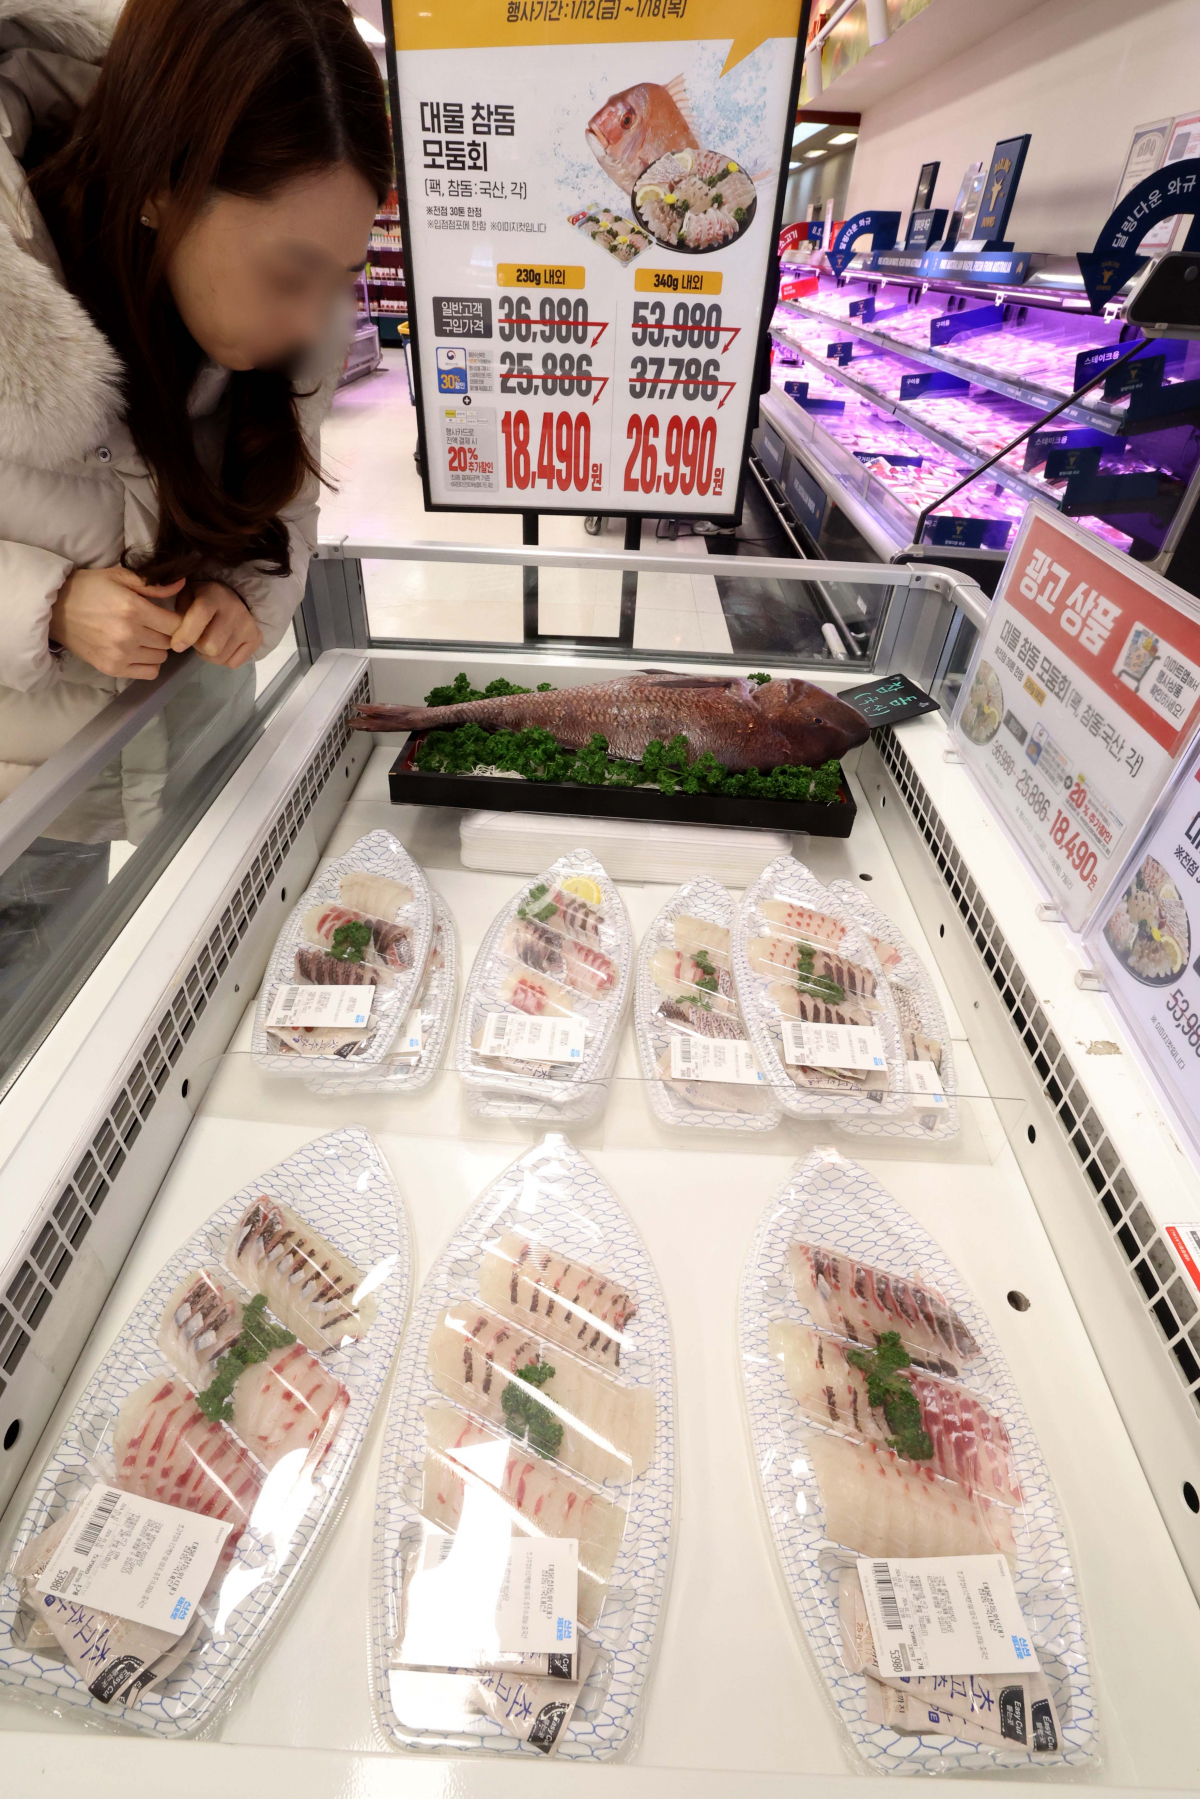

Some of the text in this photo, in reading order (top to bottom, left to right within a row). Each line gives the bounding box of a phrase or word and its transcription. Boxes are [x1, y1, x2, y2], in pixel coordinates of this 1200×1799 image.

[421, 101, 516, 136] 대물 참돔
[423, 140, 488, 173] 모둠회
[511, 181, 526, 200] 각)
[467, 207, 482, 217] 한정
[1112, 174, 1197, 249] 달링다운 와규
[516, 269, 565, 286] 230g 내외
[653, 273, 703, 291] 340g 내외
[442, 301, 482, 317] 일반고객
[443, 319, 483, 334] 구입가격
[498, 295, 589, 345] 36,980
[631, 301, 723, 350] 53,980
[1084, 351, 1120, 365] 스테이크용
[500, 351, 593, 397] 25,886
[629, 356, 721, 402] 37,786
[1035, 436, 1068, 445] 스테이크용
[448, 446, 478, 472] 20%
[468, 462, 493, 474] 추가할인
[1019, 548, 1123, 656] 광고 상품
[999, 619, 1022, 653] 대물
[1018, 636, 1041, 671] 참돔
[1036, 653, 1071, 704] 모둠회
[48, 1568, 68, 1591] 53980
[169, 1595, 186, 1620] 제대로
[177, 1600, 192, 1620] 신선
[563, 1619, 571, 1638] 신선
[1010, 1635, 1024, 1659] 제대로
[1018, 1637, 1031, 1657] 신선
[889, 1649, 903, 1672] 53980
[113, 1668, 130, 1688] Easy
[1042, 1716, 1052, 1736] Easy
